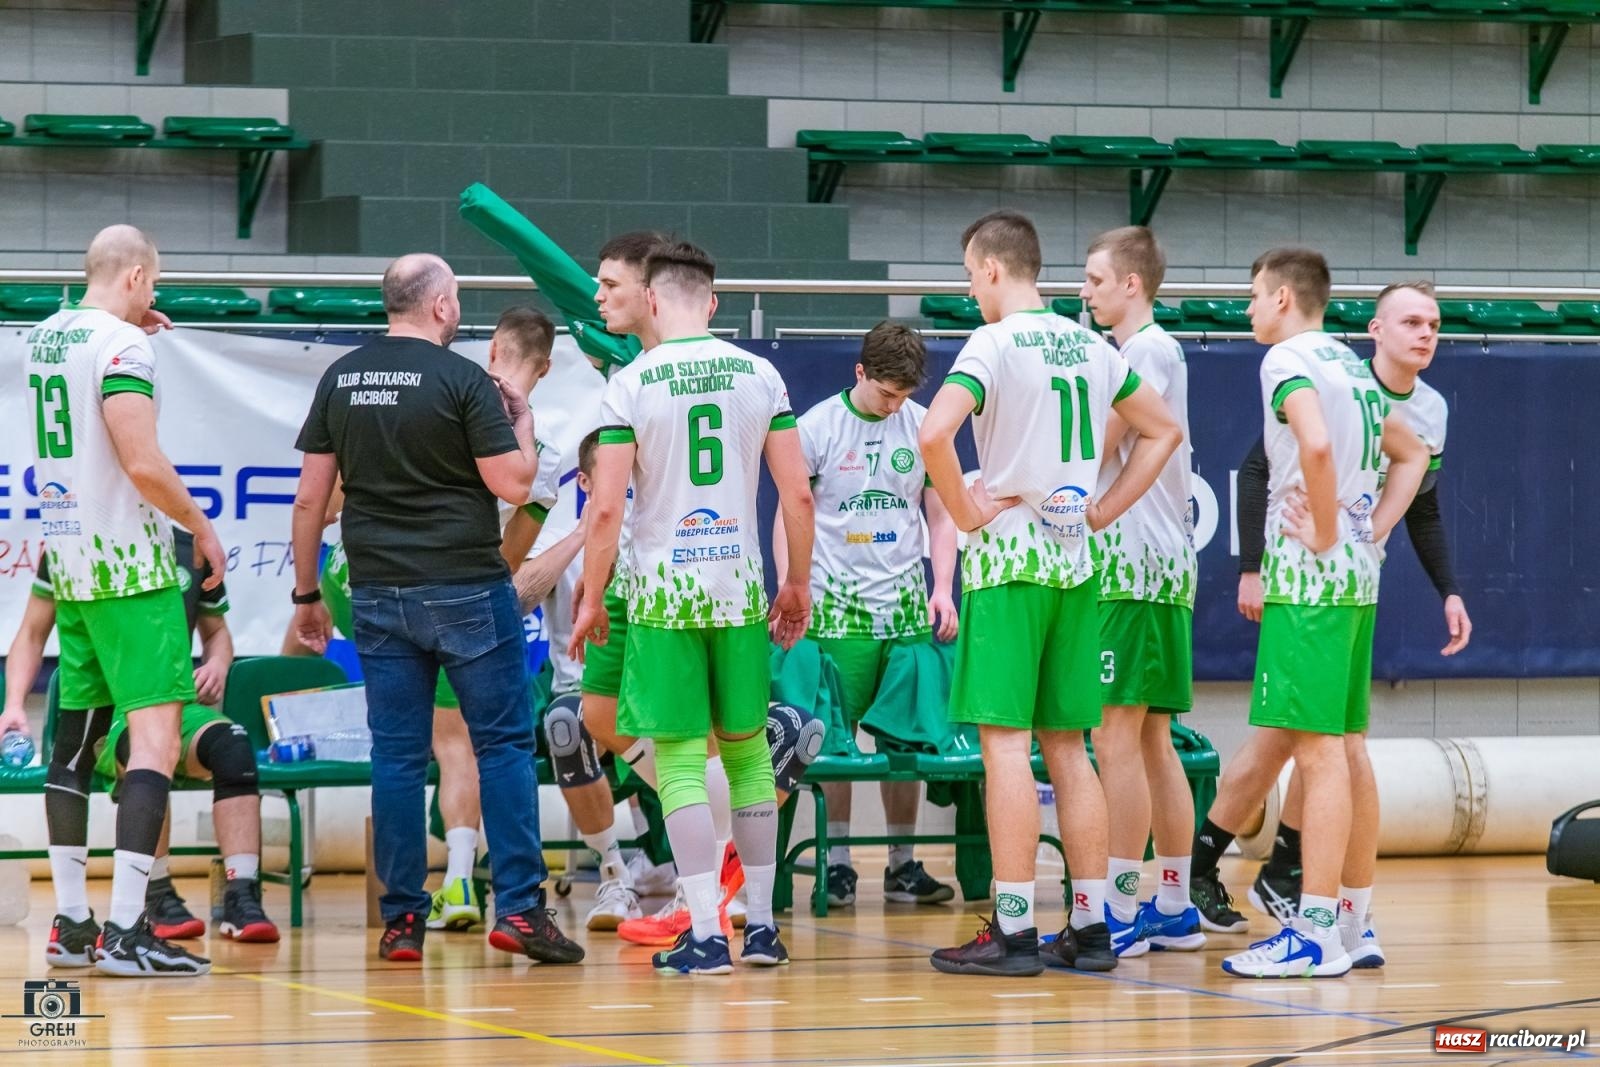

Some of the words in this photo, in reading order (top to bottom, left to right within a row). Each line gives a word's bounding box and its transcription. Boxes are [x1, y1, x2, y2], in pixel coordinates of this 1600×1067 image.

[337, 372, 361, 388] KLUB
[362, 371, 422, 387] SIATKARSKI
[640, 363, 675, 385] KLUB
[677, 356, 756, 378] SIATKARSKI
[668, 374, 735, 396] RACIBÓRZ
[350, 388, 399, 406] RACIBÓRZ
[29, 373, 74, 459] 13
[1051, 375, 1095, 463] 11
[687, 403, 724, 487] 6
[675, 525, 739, 537] UBEZPIECZENIA
[671, 544, 740, 563] ENTECO
[1163, 869, 1180, 882] R
[1075, 892, 1089, 907] R
